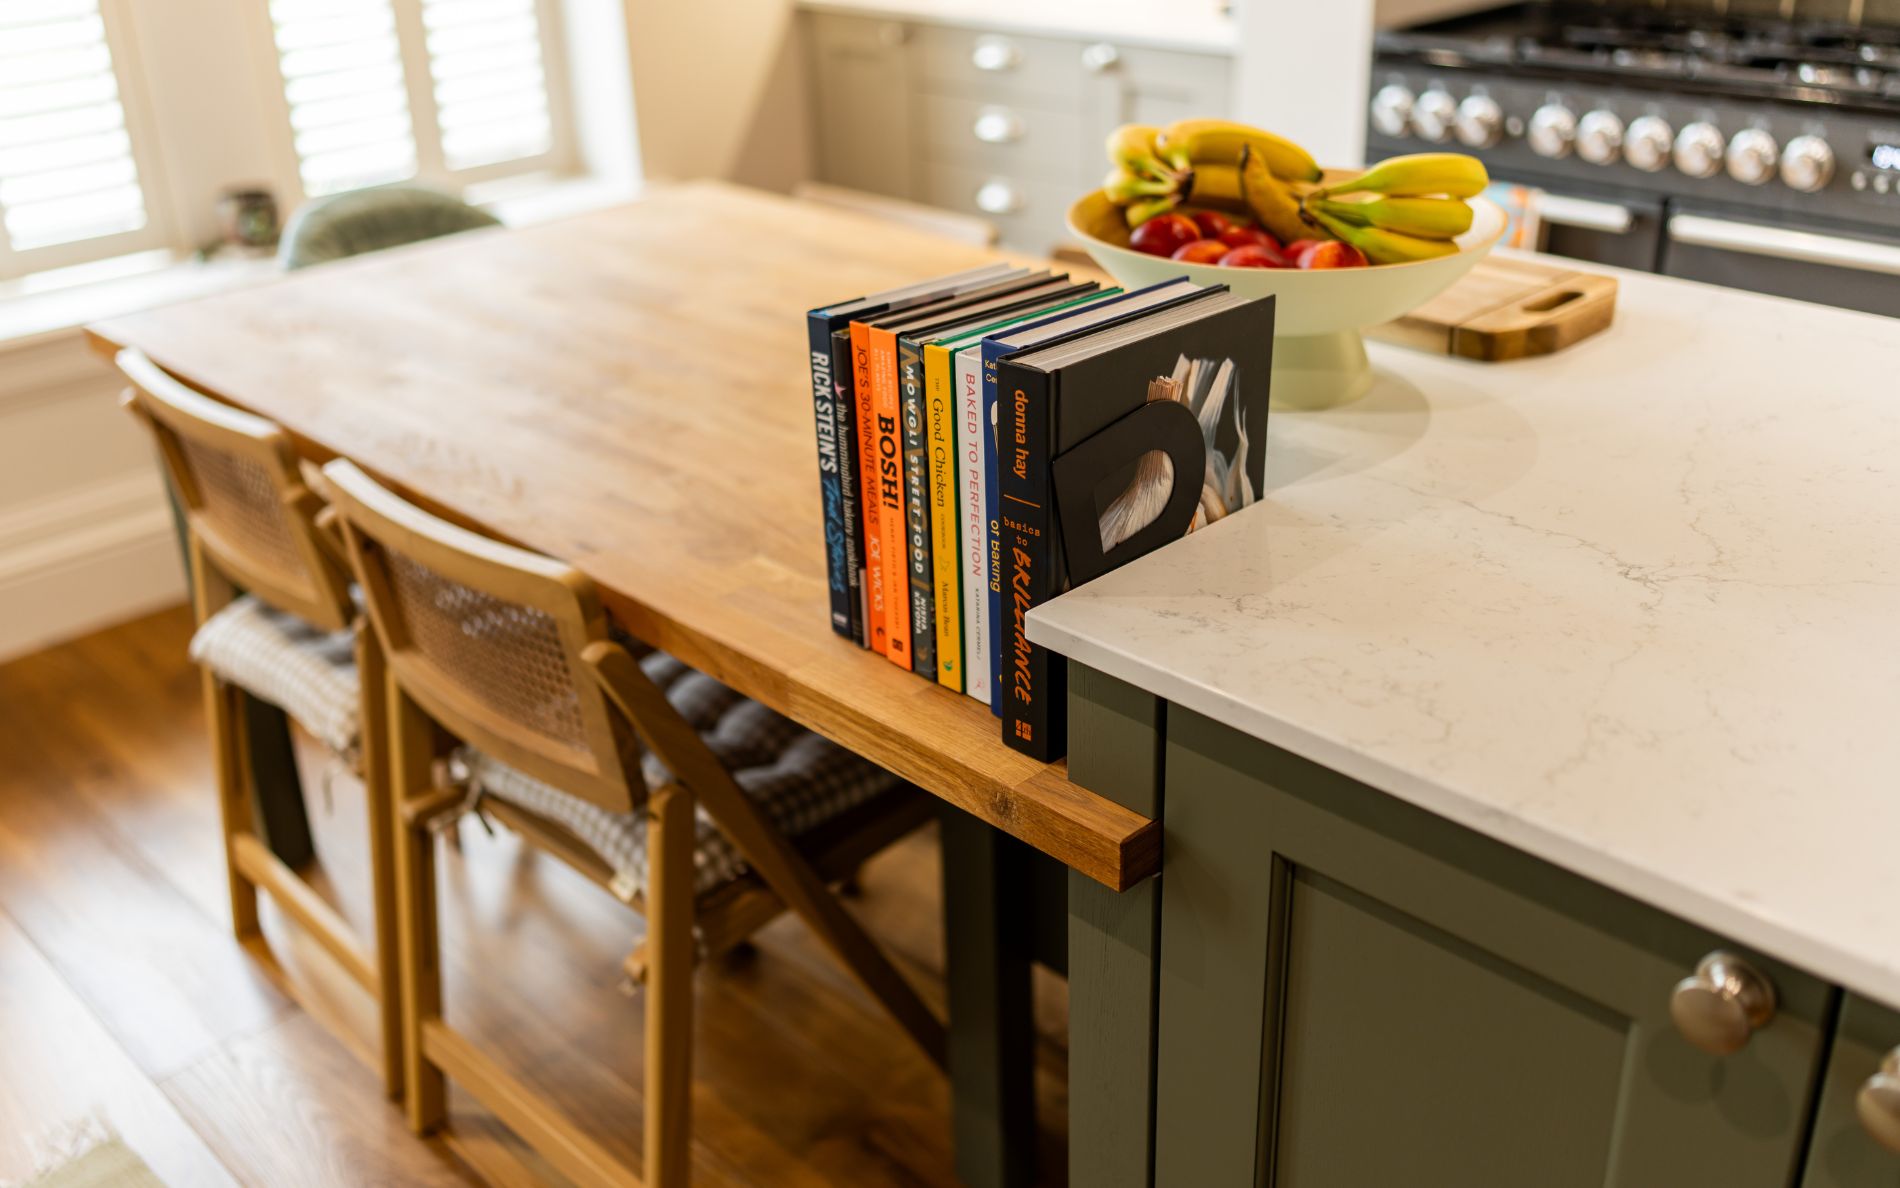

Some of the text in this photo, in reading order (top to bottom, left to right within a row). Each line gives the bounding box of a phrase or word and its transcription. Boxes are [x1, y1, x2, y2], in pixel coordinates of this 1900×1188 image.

[811, 351, 838, 473] RICK STEIN'S
[857, 345, 879, 526] JOE'S 30-MINUTE MEALS
[933, 397, 945, 442] Good
[1012, 389, 1030, 480] donna hay
[836, 403, 859, 587] the hummingbird bakery cookbook
[878, 412, 899, 511] BOSH!
[905, 365, 924, 574] MOWGLI STREET FOOD
[934, 446, 947, 507] Chicken
[965, 373, 982, 577] BAKED TO PERFECTION
[1003, 515, 1041, 537] basics
[1016, 534, 1028, 547] to
[870, 534, 883, 612] JOE WICKS
[914, 591, 922, 634] KATONA
[918, 596, 927, 630] NISHA
[941, 580, 949, 613] Marcus
[1012, 546, 1032, 706] BRILLIANCE
